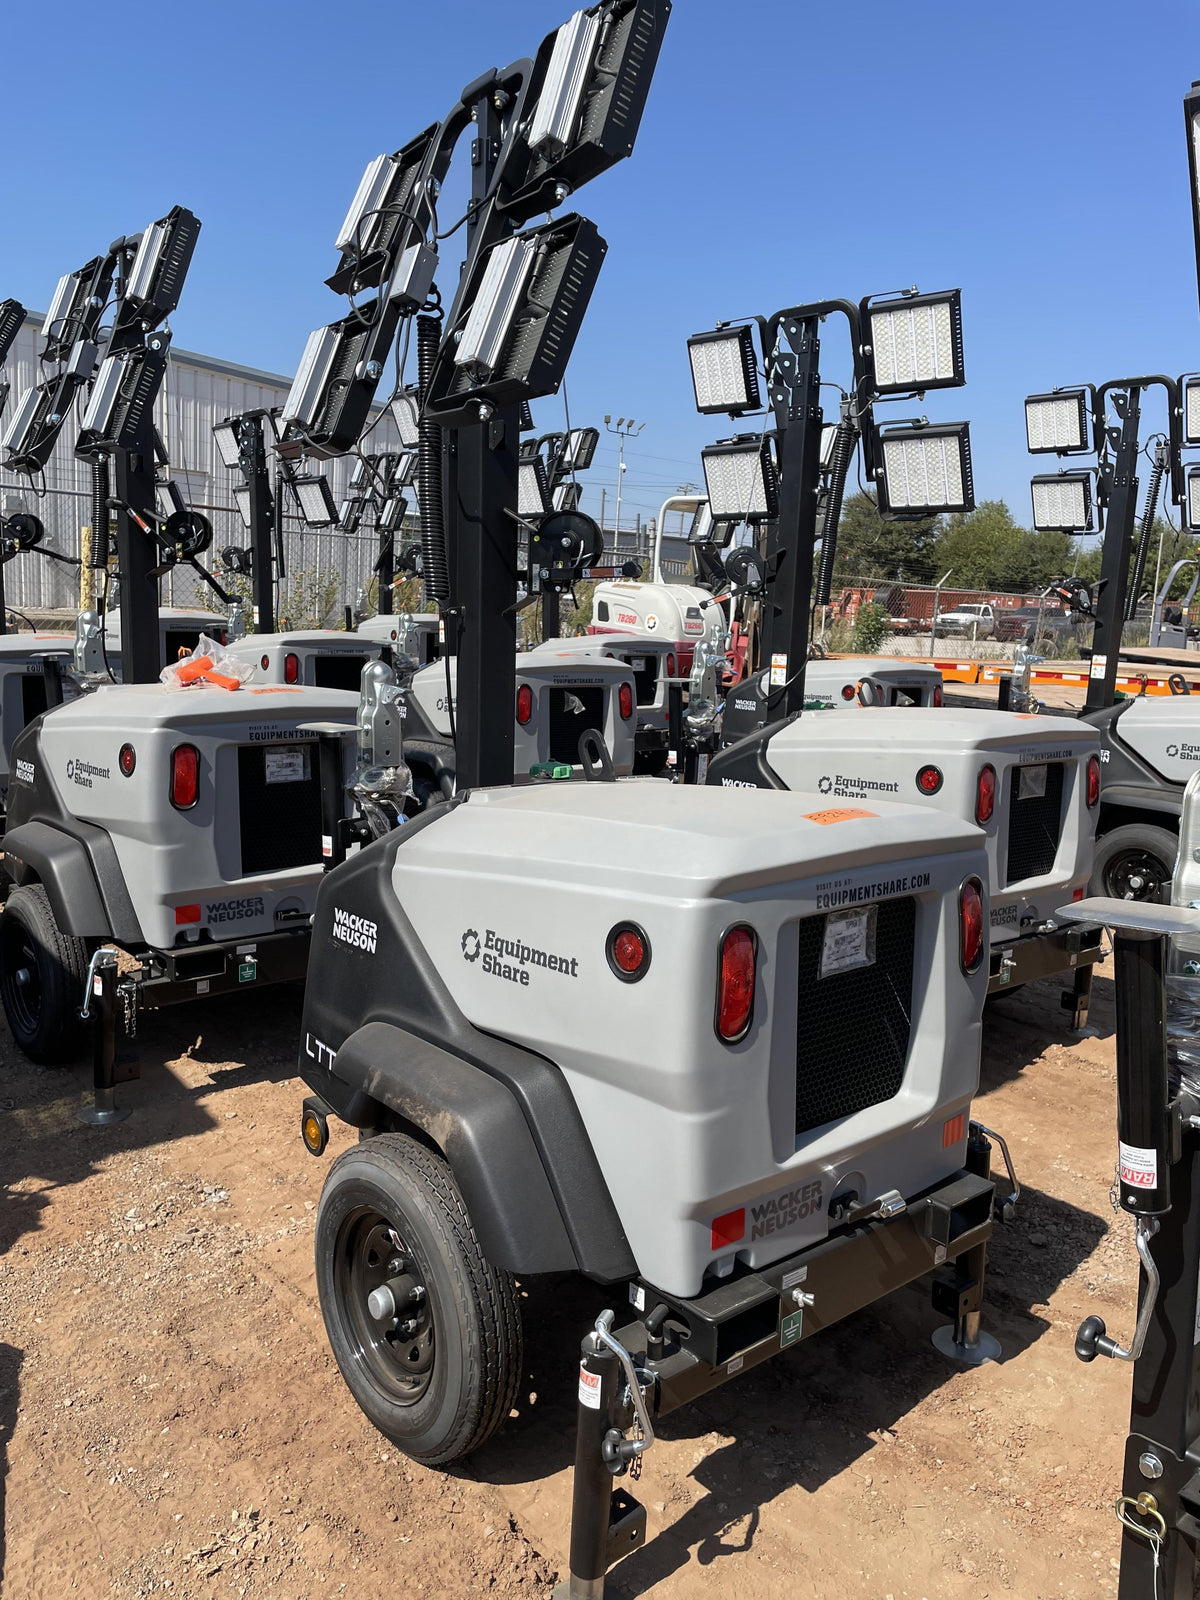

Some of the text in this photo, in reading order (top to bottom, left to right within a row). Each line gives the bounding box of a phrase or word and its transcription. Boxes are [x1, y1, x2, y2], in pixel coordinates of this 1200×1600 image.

[617, 613, 637, 625] TB260
[803, 692, 832, 702] quipment
[249, 730, 320, 740] EQUIPMENTSHA
[75, 759, 110, 779] Equipment
[74, 773, 92, 788] Share
[834, 775, 899, 792] Equipment
[816, 881, 832, 891] VISIT
[816, 872, 931, 909] EQUIPMENTSHARE.COM
[206, 897, 264, 913] WACKER
[207, 906, 264, 924] NEUSON
[334, 907, 377, 939] WACKER
[991, 914, 1017, 927] EUSON
[333, 922, 376, 954] NEUSON
[484, 929, 579, 978] Equipment
[482, 953, 530, 986] Share
[1121, 1166, 1154, 1184] RAM
[751, 1180, 822, 1223] WACKER
[751, 1195, 822, 1241] NEUSON
[580, 1371, 598, 1388] AM
